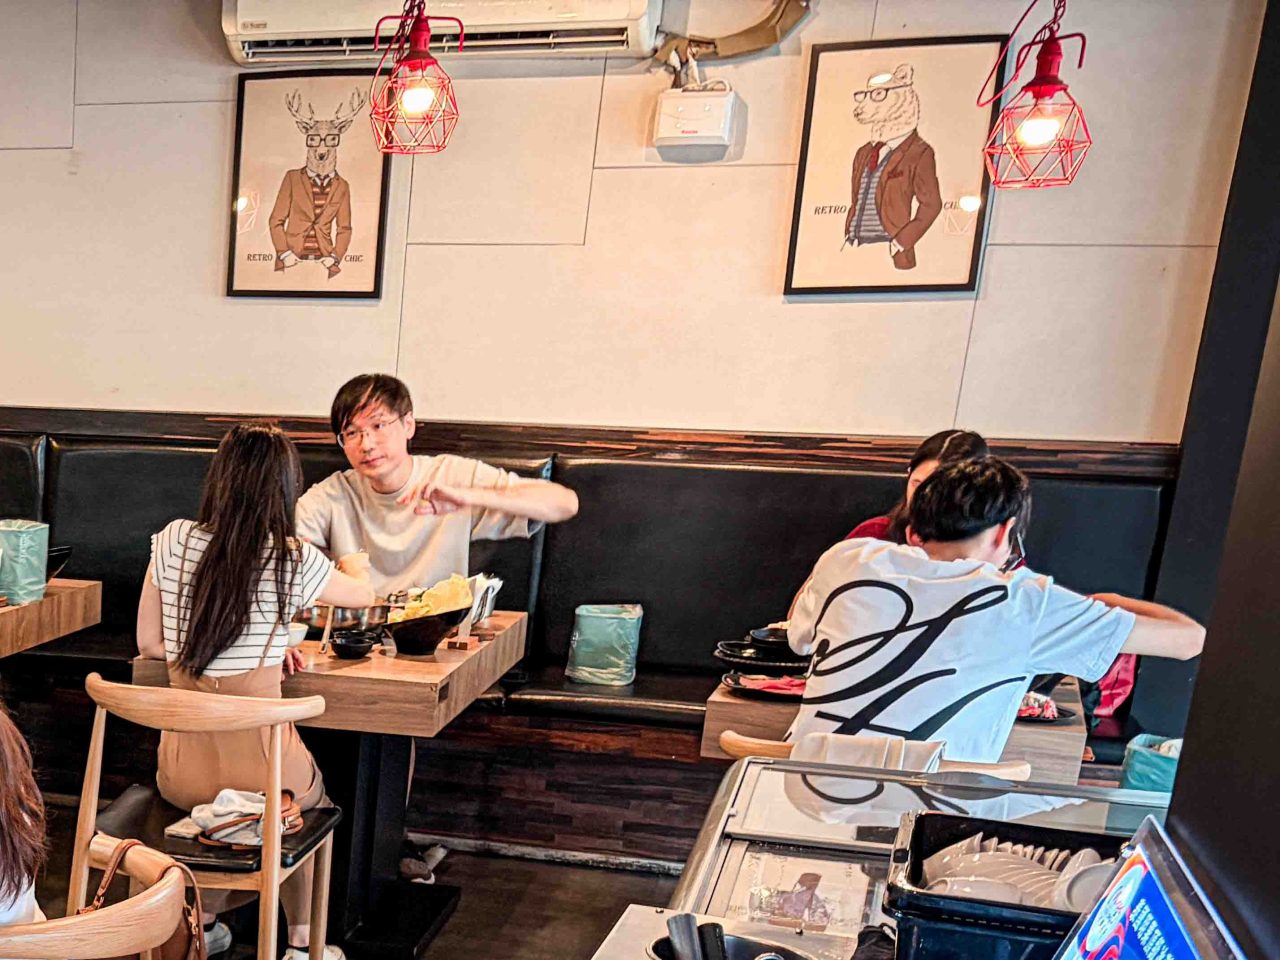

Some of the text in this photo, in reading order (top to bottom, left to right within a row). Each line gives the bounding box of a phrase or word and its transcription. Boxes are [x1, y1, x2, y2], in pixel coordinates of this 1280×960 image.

[814, 204, 847, 215] RETRO
[247, 253, 364, 263] RETRO CHIC
